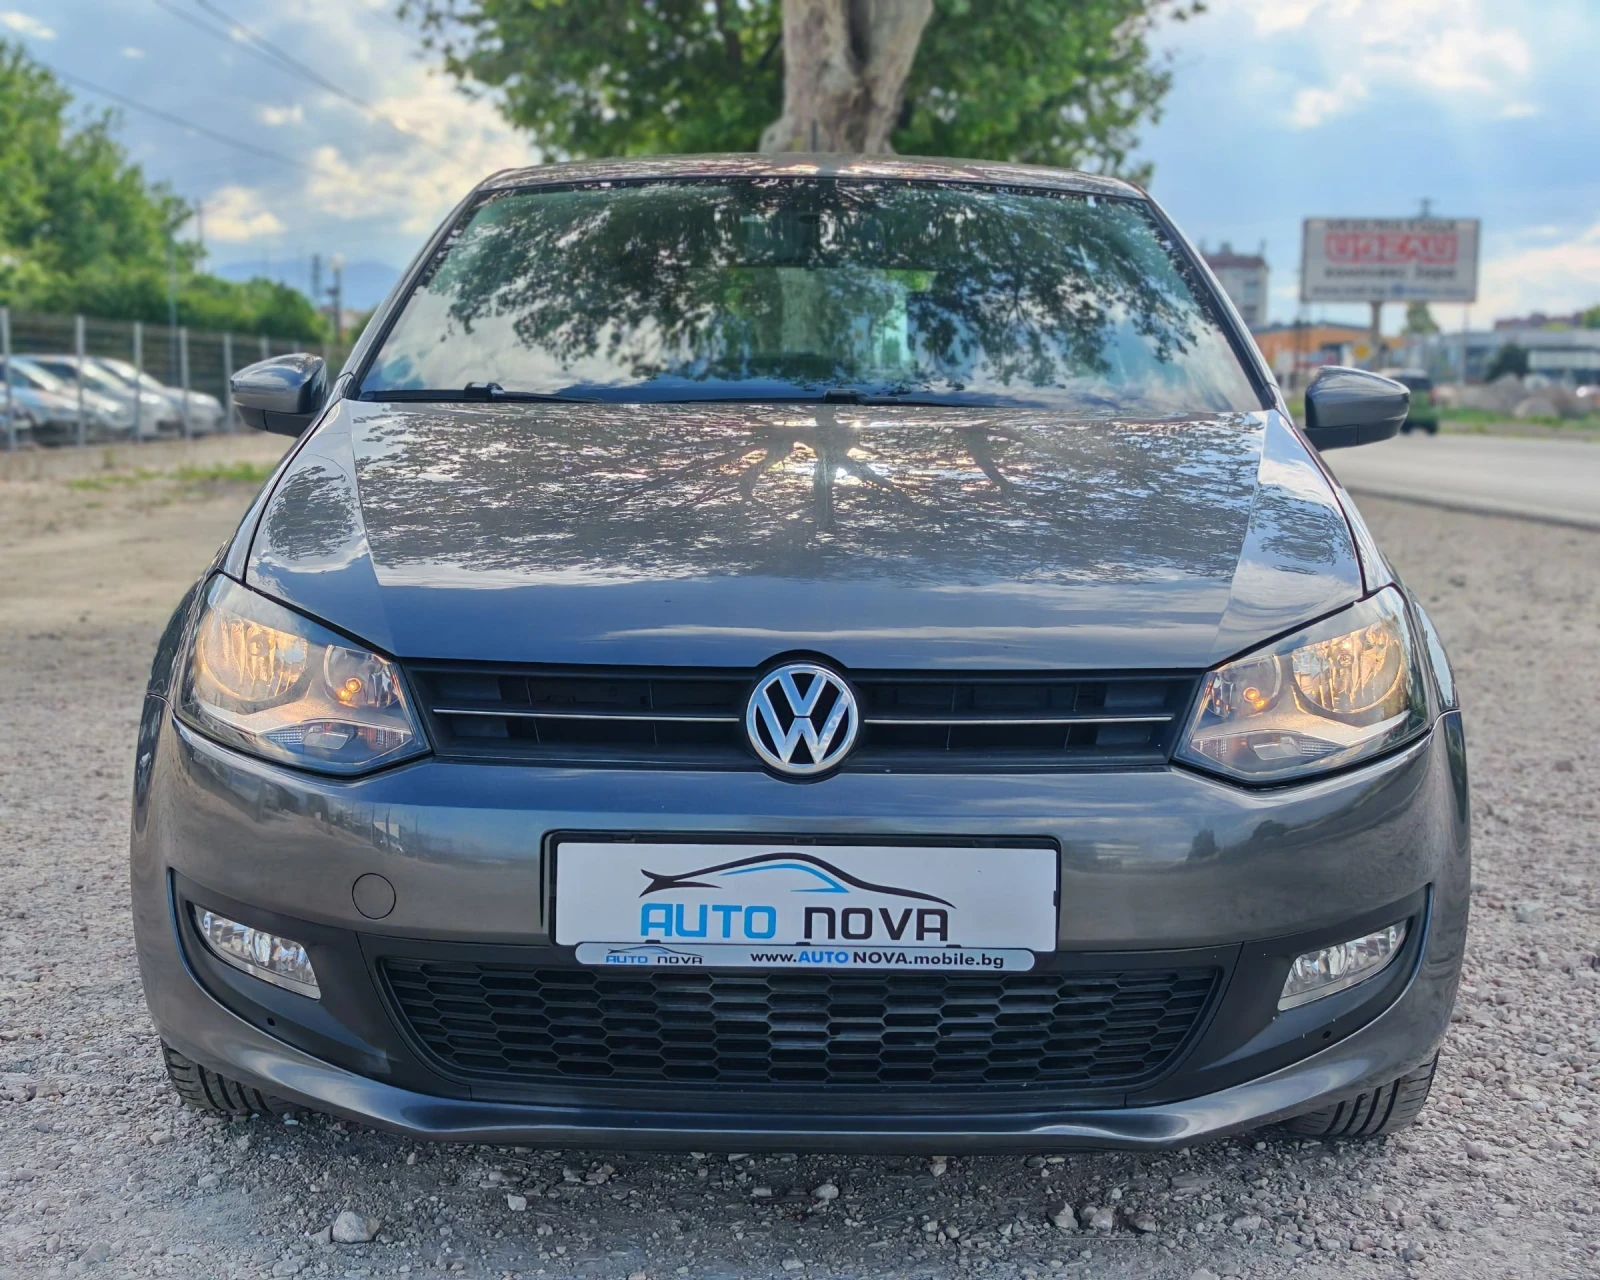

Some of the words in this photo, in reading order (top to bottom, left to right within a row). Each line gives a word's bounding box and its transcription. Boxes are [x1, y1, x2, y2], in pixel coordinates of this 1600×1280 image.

[747, 664, 858, 773] VW
[640, 902, 777, 939] AUTO
[803, 906, 949, 942] NOVA
[605, 955, 649, 964] AUTO
[657, 956, 704, 965] NOVA
[750, 950, 849, 964] www.AUTO
[852, 951, 1004, 969] NOVA.mobile.bg
